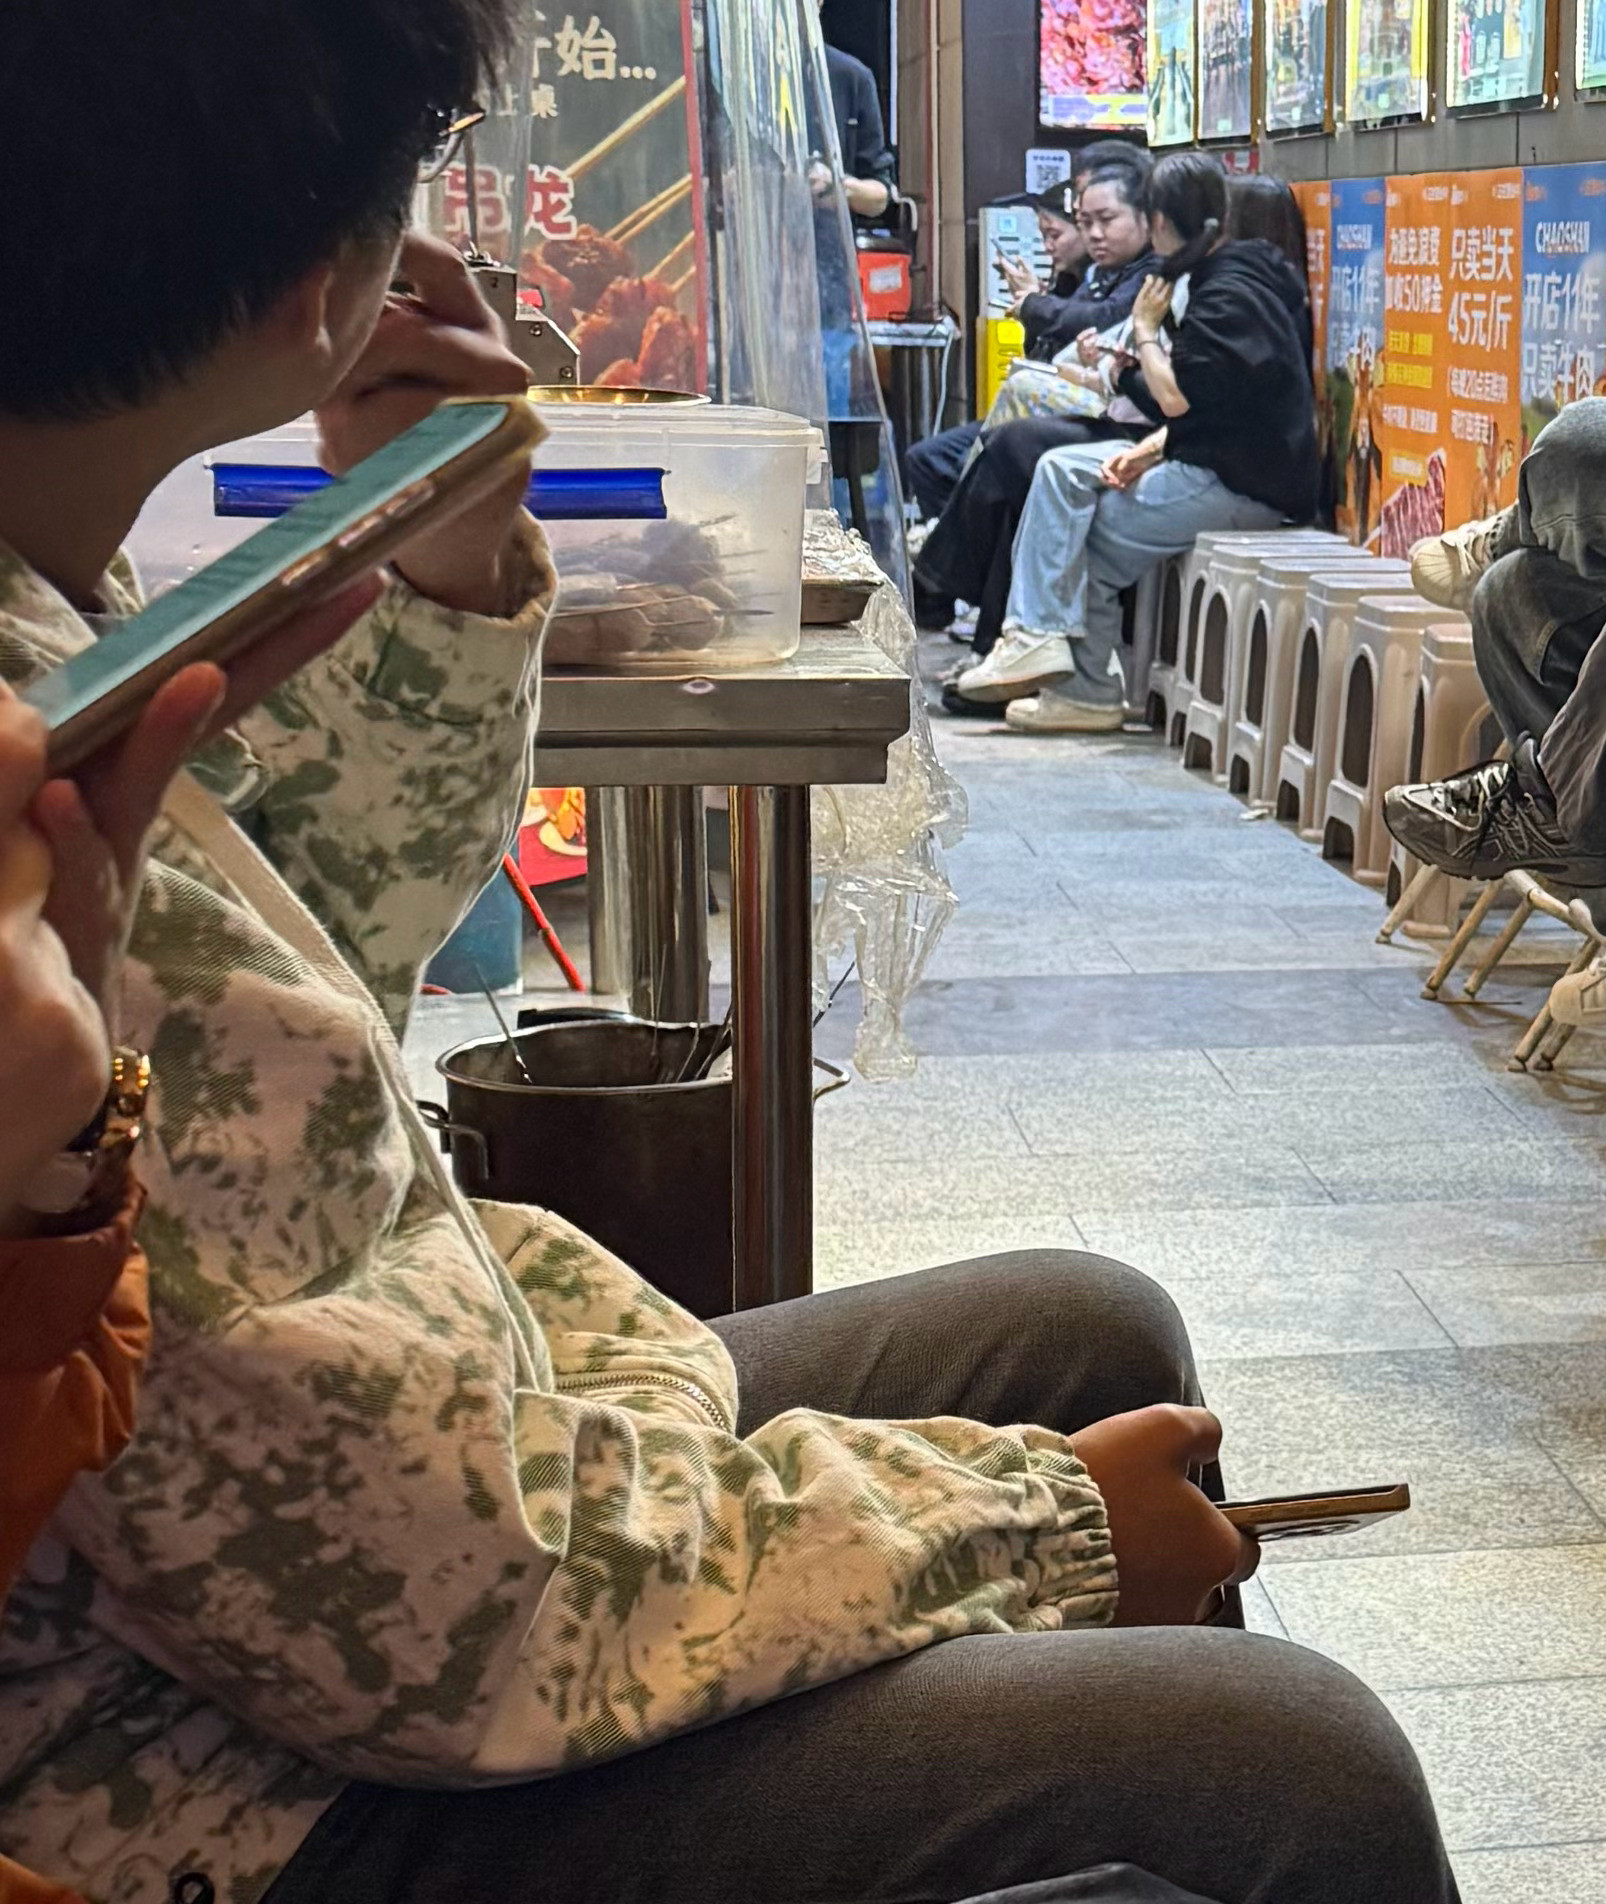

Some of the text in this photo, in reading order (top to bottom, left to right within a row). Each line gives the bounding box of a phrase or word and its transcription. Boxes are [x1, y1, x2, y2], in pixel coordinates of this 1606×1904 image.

[1450, 225, 1514, 282] 只卖当天
[1448, 290, 1513, 352] 45元/斤
[1523, 270, 1600, 334] 开店11年
[1522, 342, 1597, 403] 只卖牛肉
